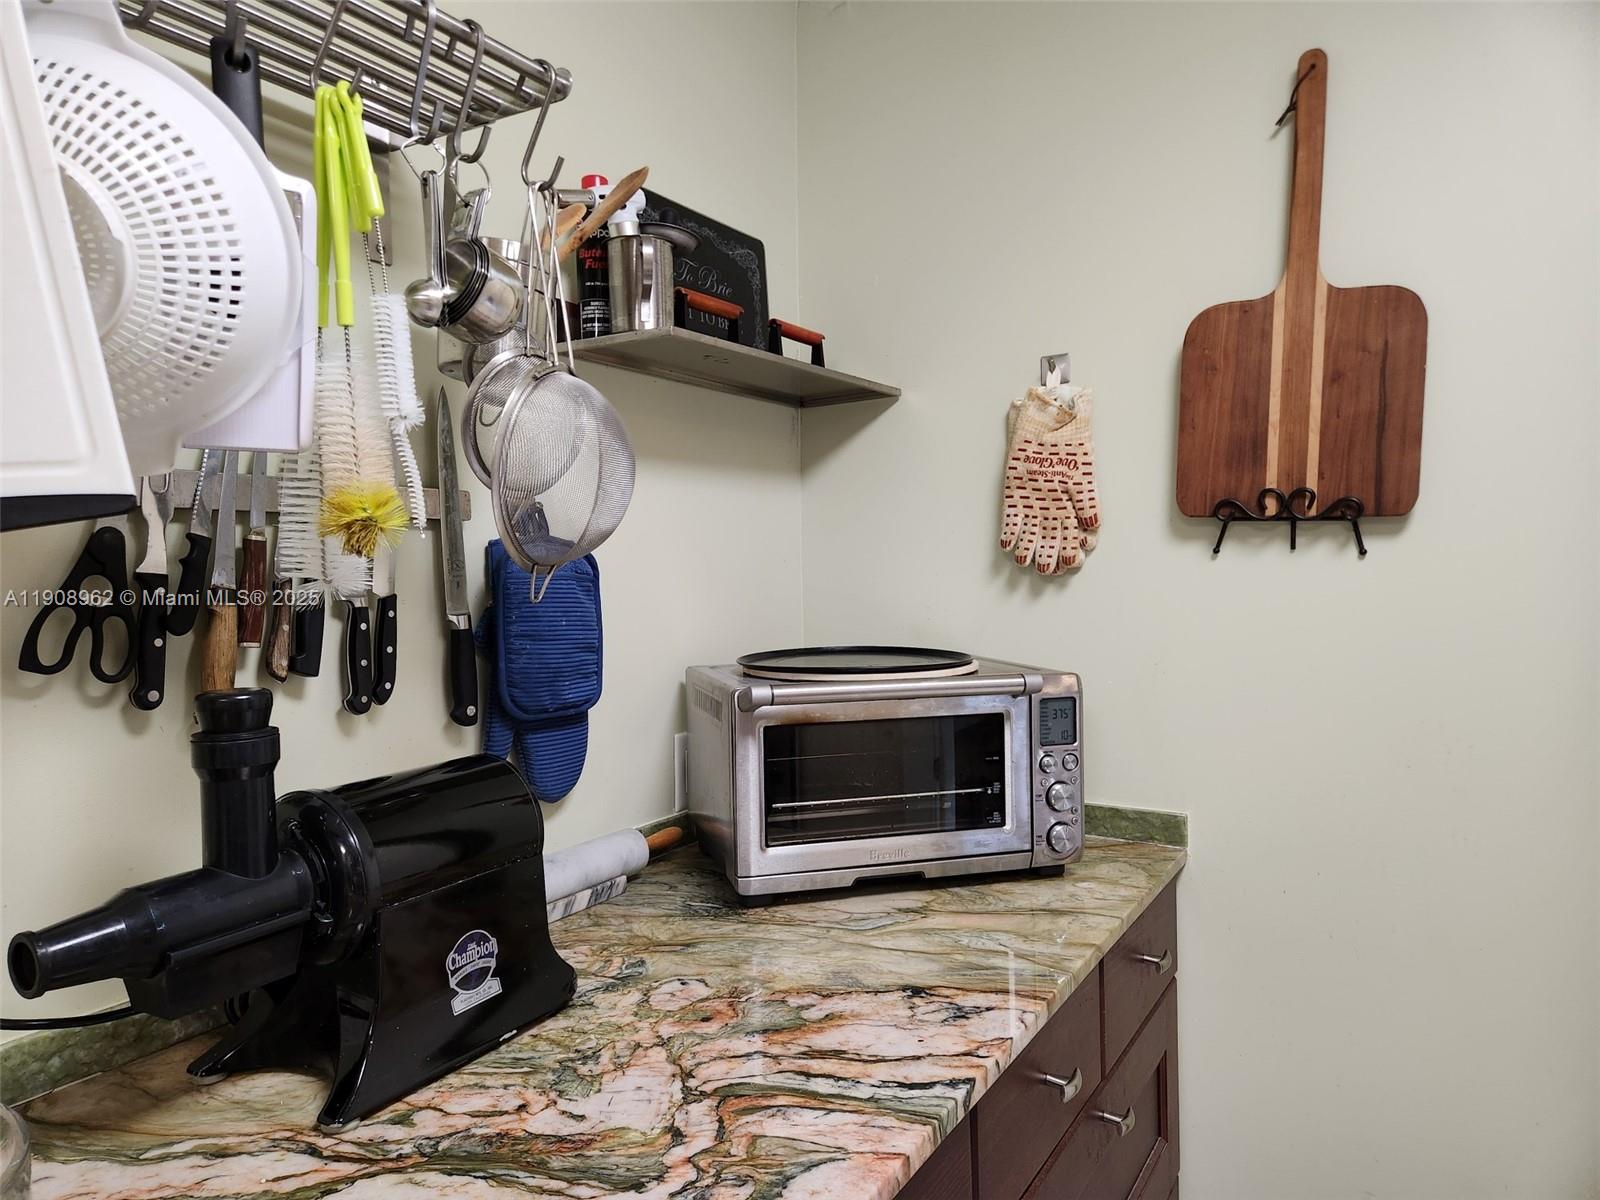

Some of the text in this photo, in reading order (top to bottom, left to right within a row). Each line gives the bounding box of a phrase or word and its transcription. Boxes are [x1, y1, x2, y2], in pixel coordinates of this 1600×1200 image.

[674, 256, 733, 297] To Brie
[1023, 454, 1053, 469] Glove
[1026, 469, 1067, 479] Anti-Steam
[869, 847, 912, 861] Breville
[448, 940, 496, 970] Champion
